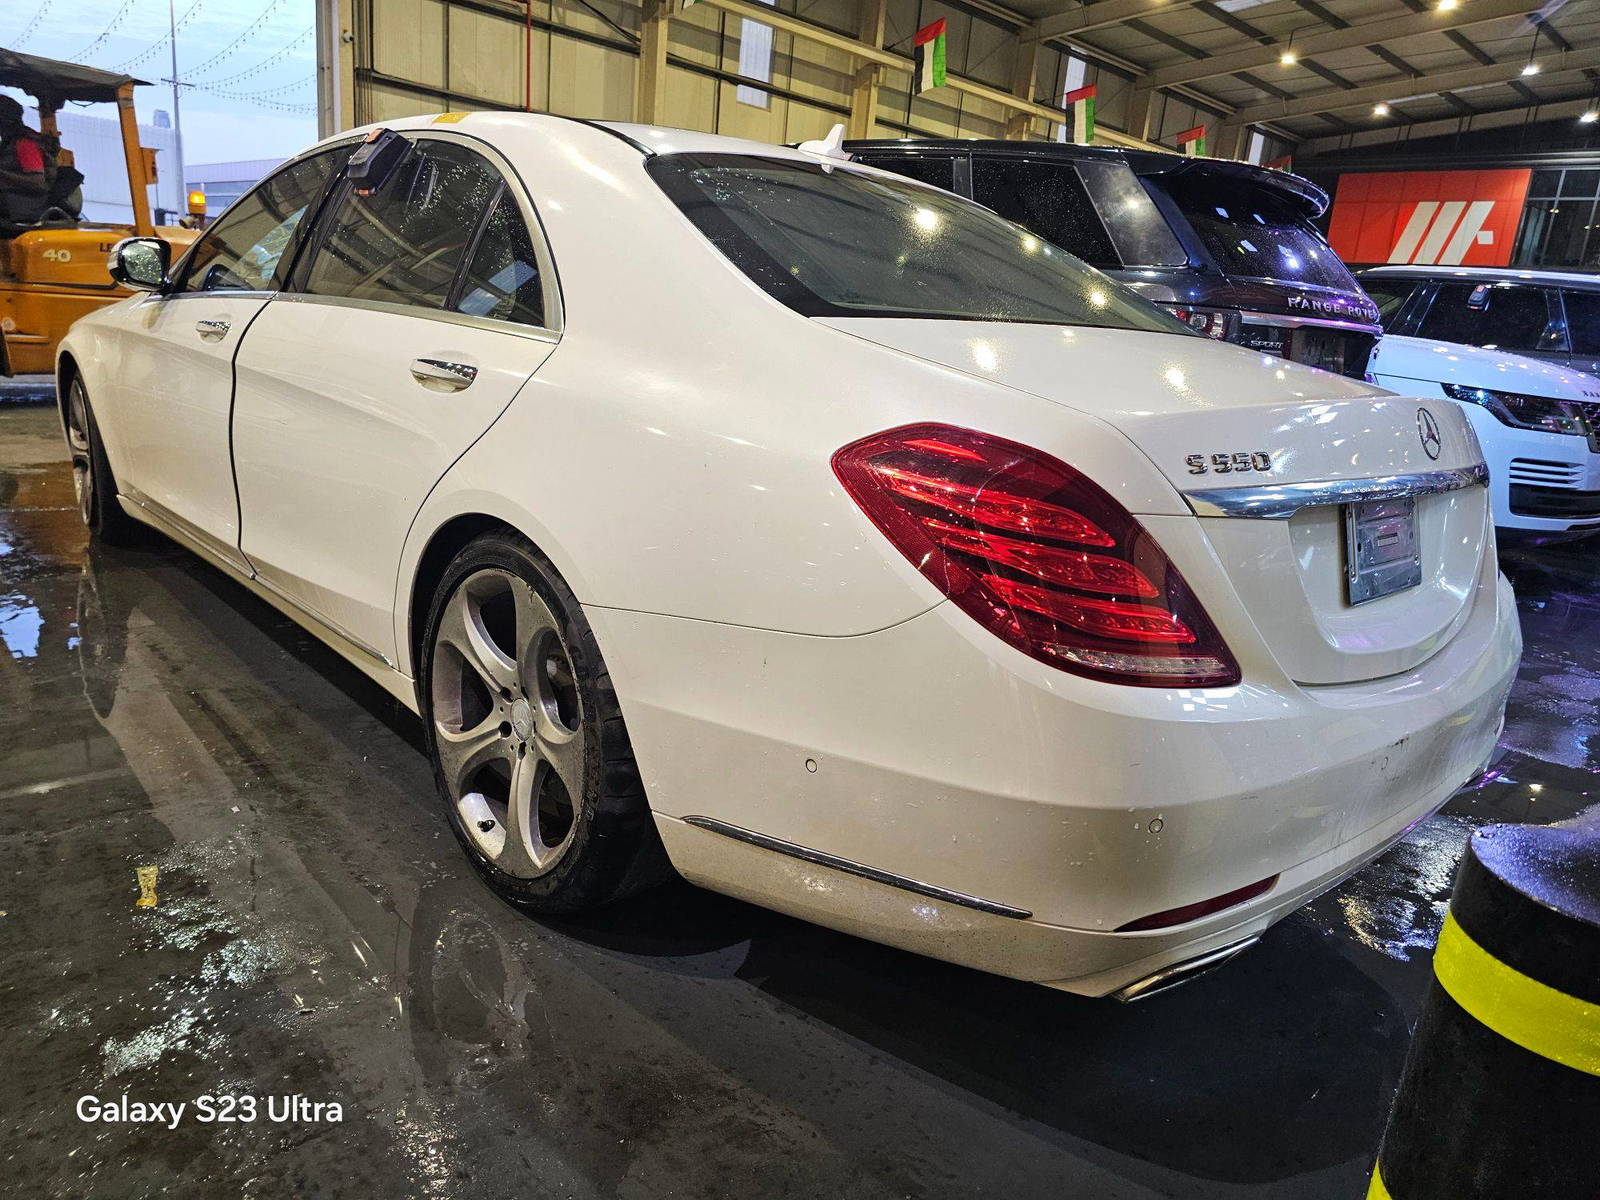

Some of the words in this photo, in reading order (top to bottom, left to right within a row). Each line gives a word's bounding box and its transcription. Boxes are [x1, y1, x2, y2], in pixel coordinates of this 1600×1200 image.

[43, 248, 72, 263] 40
[1288, 297, 1341, 313] RANGE
[1185, 454, 1209, 475] S
[1211, 451, 1272, 474] 550
